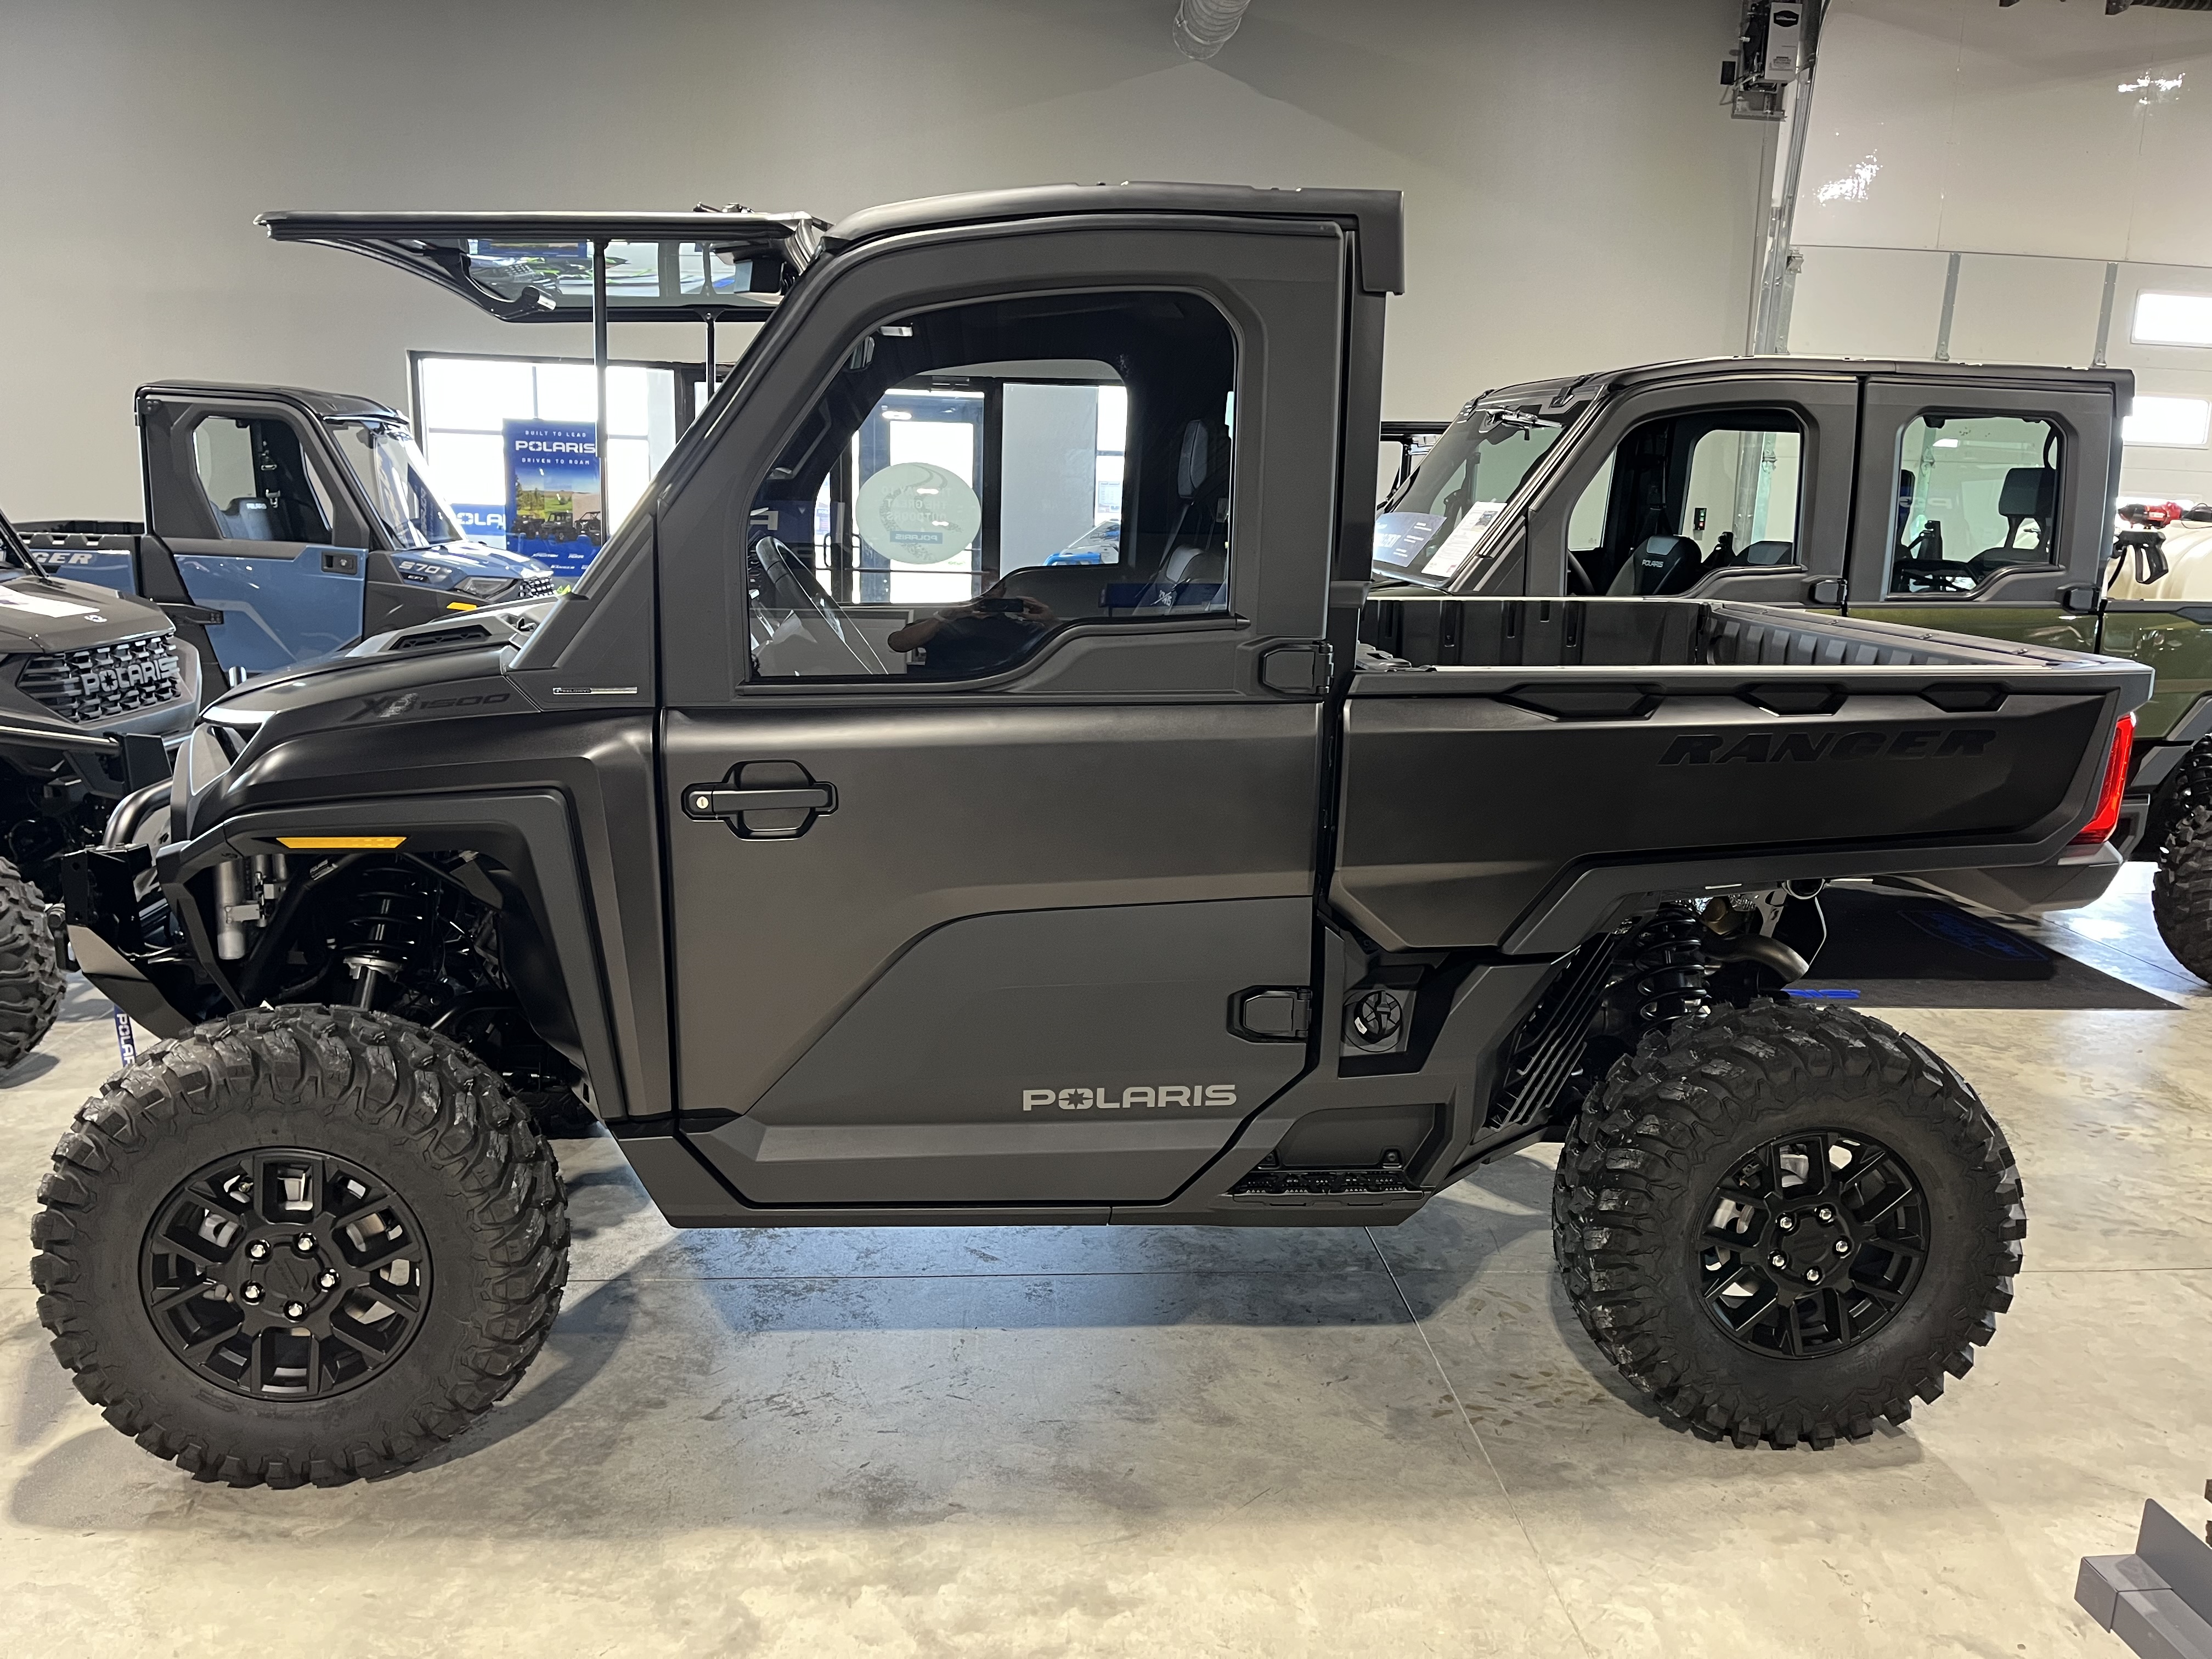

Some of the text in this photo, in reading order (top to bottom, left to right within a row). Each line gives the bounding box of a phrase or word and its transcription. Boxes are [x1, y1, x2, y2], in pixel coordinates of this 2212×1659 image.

[515, 441, 596, 453] POLARIS
[81, 656, 180, 696] POLARIS
[419, 693, 511, 710] 1500
[1656, 729, 1997, 765] RANGER
[1023, 1084, 1237, 1111] POLARIS
